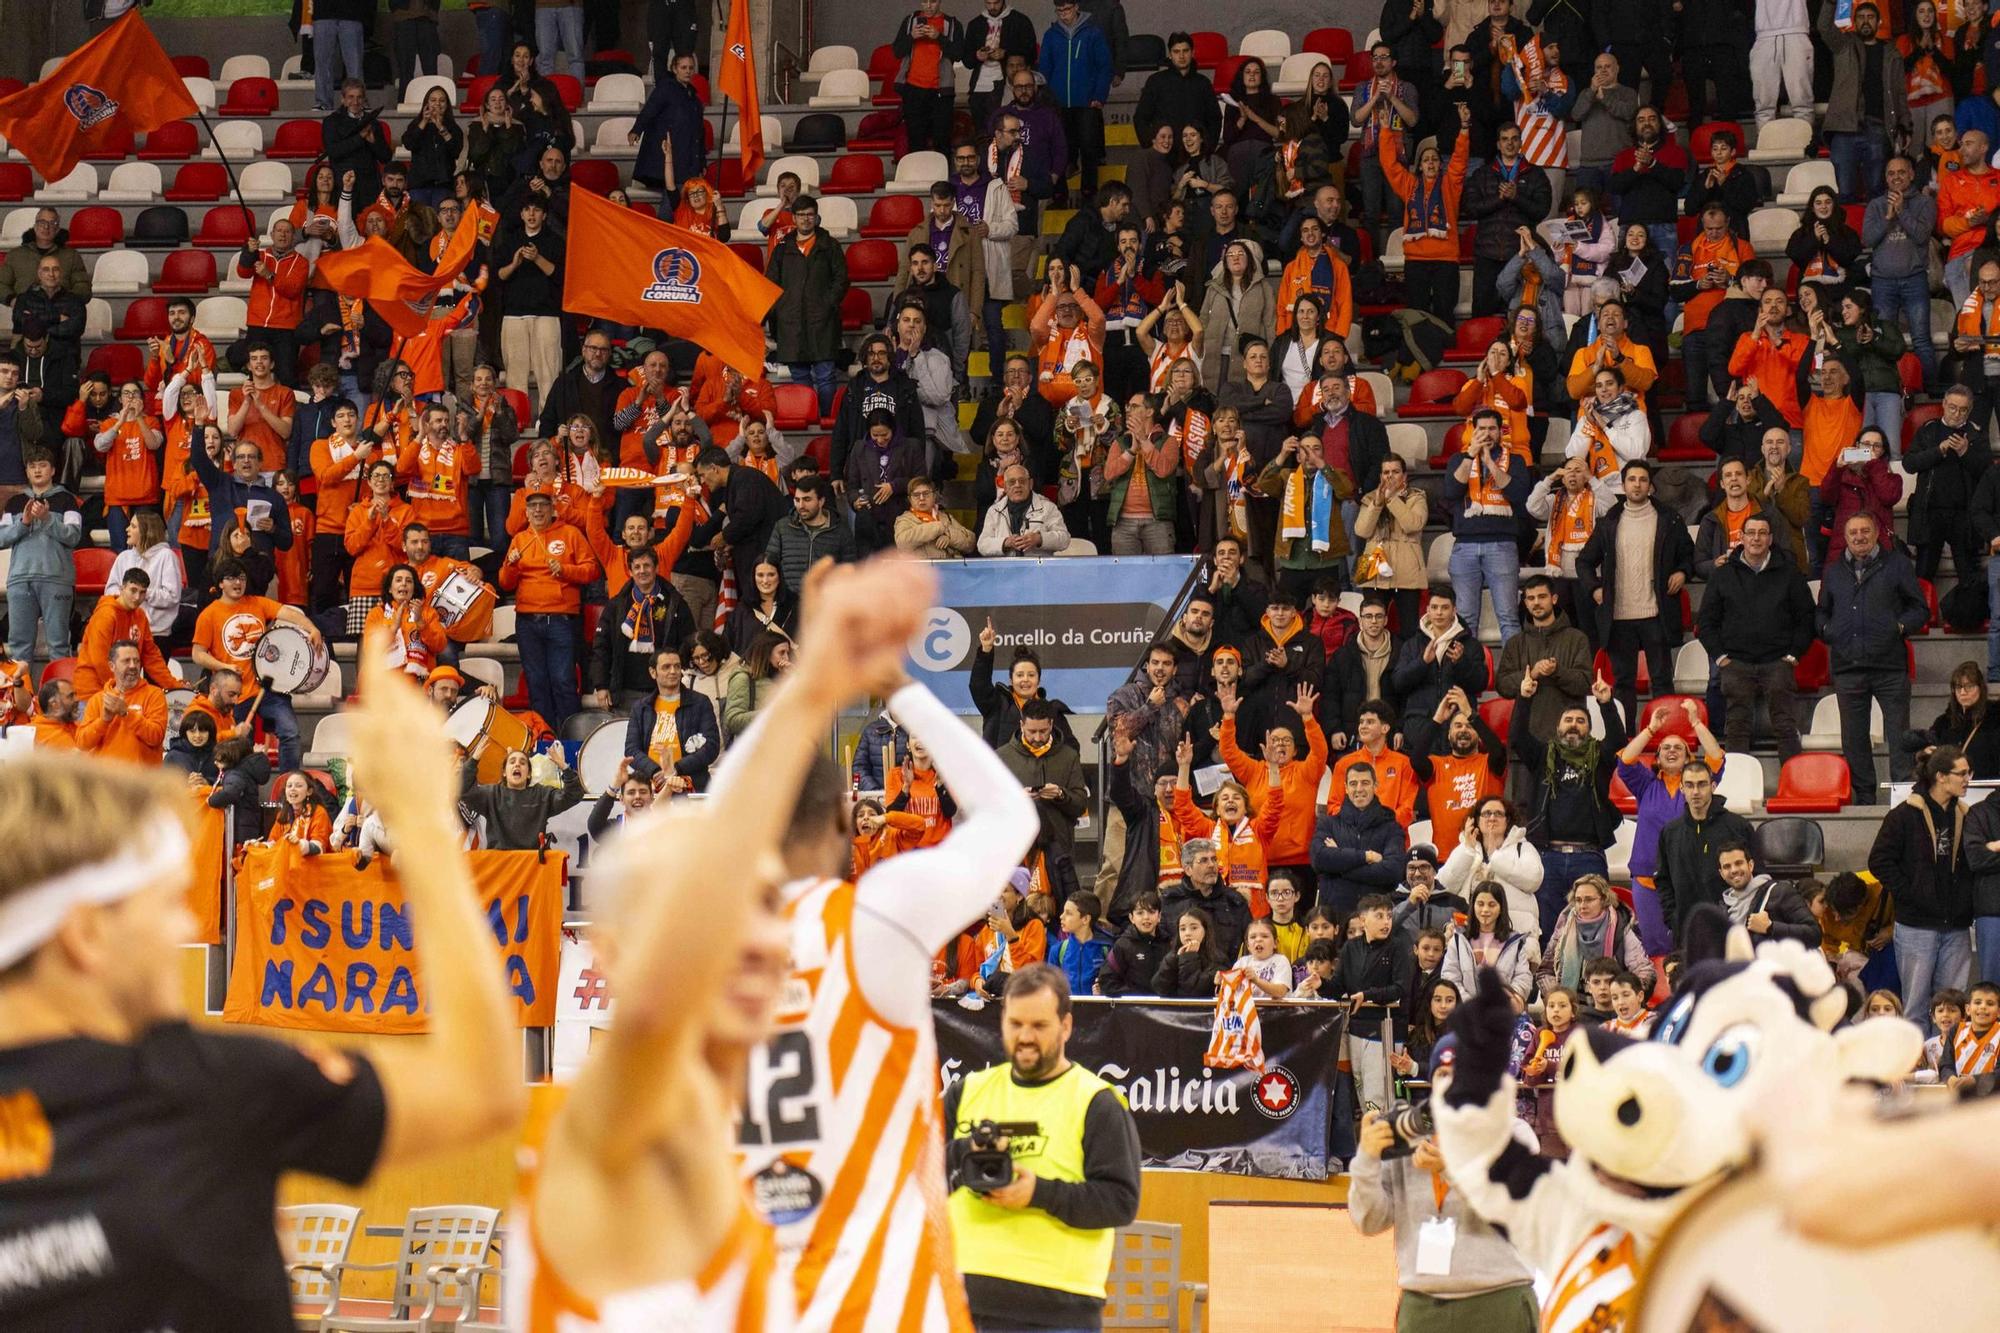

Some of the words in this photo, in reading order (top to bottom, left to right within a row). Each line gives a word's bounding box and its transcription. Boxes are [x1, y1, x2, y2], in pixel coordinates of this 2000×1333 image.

[993, 629, 1056, 648] oncello
[1062, 629, 1084, 648] da
[1090, 628, 1155, 645] Coruña
[270, 893, 530, 957] TSUNI
[260, 952, 537, 1015] NARAA
